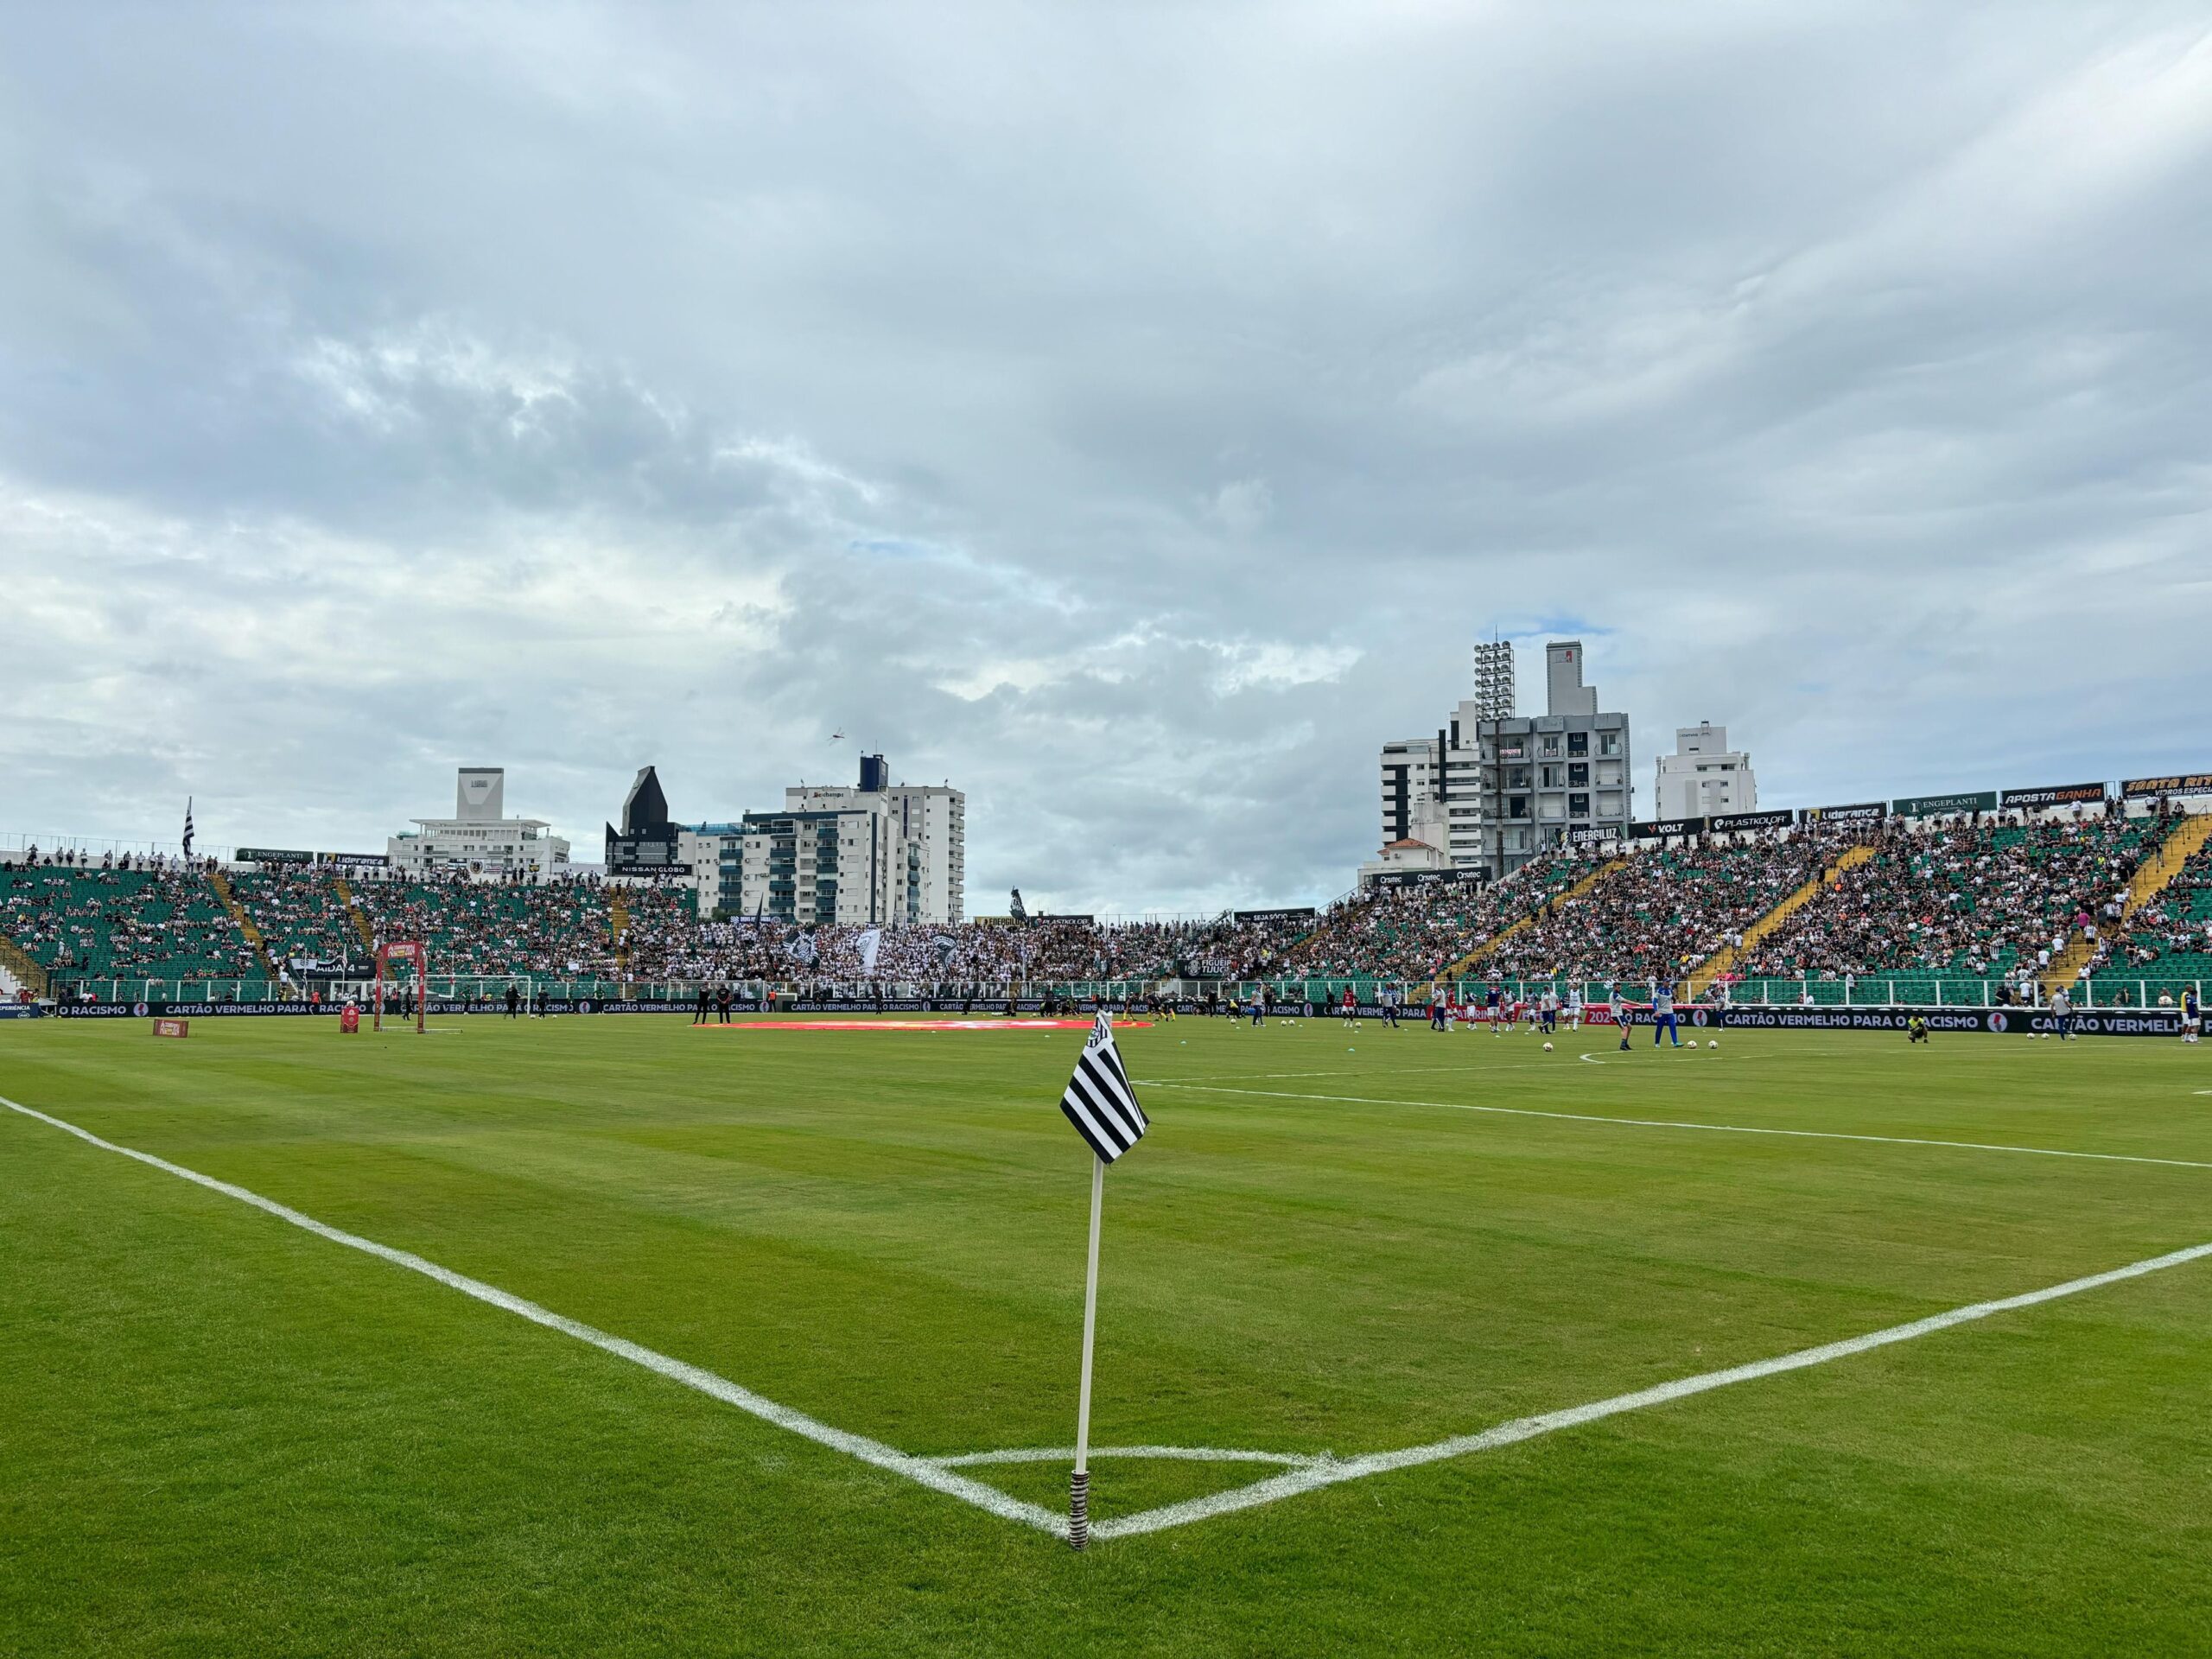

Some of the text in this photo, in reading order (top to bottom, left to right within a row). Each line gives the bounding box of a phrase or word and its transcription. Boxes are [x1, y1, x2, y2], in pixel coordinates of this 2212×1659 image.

[2126, 779, 2180, 791] SANTA
[1923, 797, 1978, 809] ENGEPLANTI
[1725, 815, 1783, 828] PLASTKOLOR
[1658, 823, 1684, 834] VOLT
[1573, 827, 1617, 842] ENERGILUZ
[347, 963, 355, 972] 4
[60, 1006, 127, 1015] O RACISMO
[166, 1003, 212, 1014] CARTÃO
[215, 1005, 275, 1014] VERMELHO
[277, 1005, 307, 1014] PARA
[603, 1002, 638, 1012] CARTÃO
[791, 1002, 821, 1011] CARTÃO
[1402, 1008, 1427, 1018] PARA
[1589, 1011, 1610, 1023] 202
[1726, 1012, 1775, 1025] CARTÃO
[1778, 1014, 1850, 1027] VERMELHO
[1853, 1015, 1892, 1027] PARA
[1895, 1016, 1906, 1027] O
